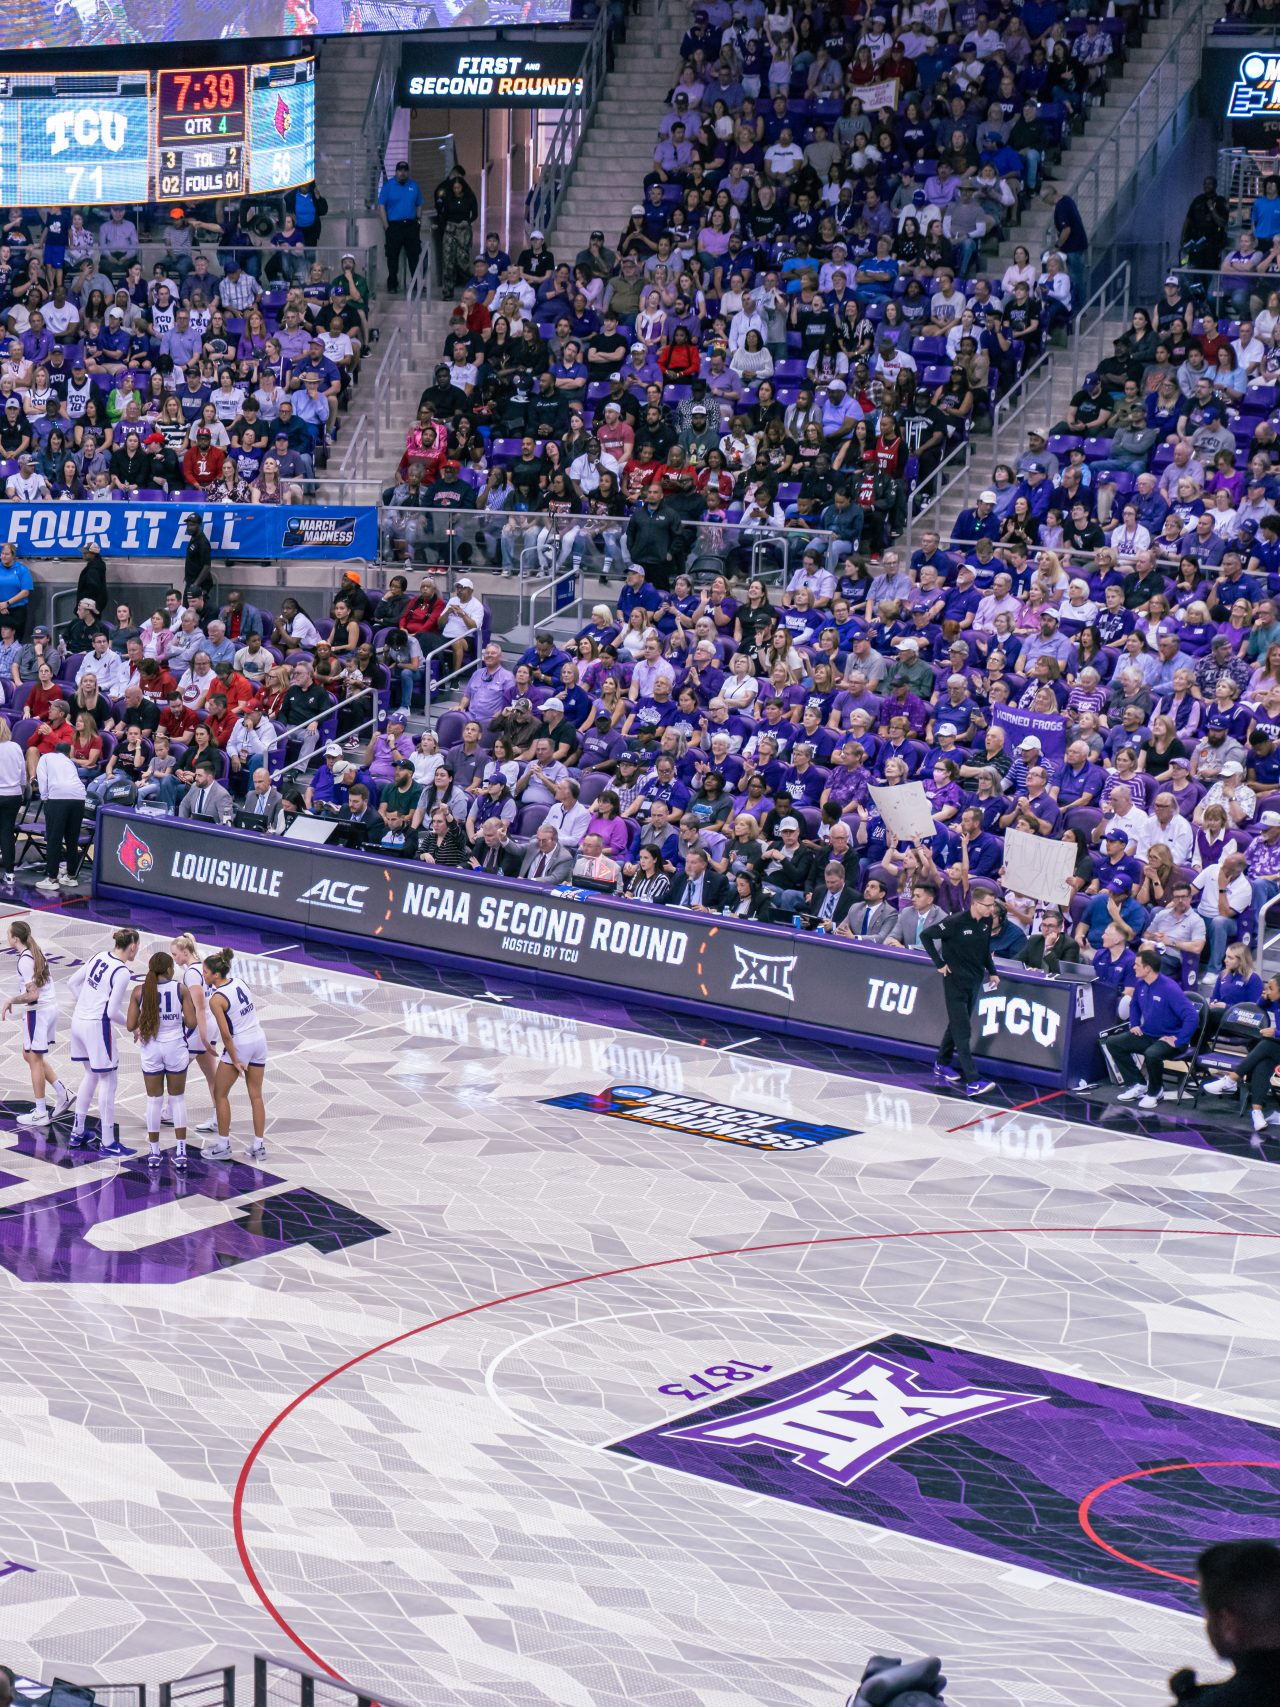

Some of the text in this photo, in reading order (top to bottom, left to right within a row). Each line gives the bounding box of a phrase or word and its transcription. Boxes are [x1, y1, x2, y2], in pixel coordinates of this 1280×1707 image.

[457, 57, 522, 74] FIRST
[173, 73, 235, 111] 7:39
[410, 78, 493, 95] SECOND
[46, 109, 128, 155] TCU
[185, 116, 227, 134] QTR 4
[167, 147, 237, 168] 3 TOL 2
[272, 151, 290, 185] 56
[66, 166, 103, 200] 71
[162, 172, 238, 193] 02 FOULS 01
[155, 316, 172, 325] TCU
[50, 374, 65, 383] TCU
[69, 395, 86, 404] TCU
[197, 460, 211, 476] L
[8, 510, 111, 548] FOUR
[121, 510, 167, 549] IT
[299, 519, 336, 531] MARCH
[303, 530, 353, 543] MADNESS
[996, 709, 1064, 732] HORNED FROGS
[1255, 723, 1279, 736] TCU
[171, 851, 283, 897] LOUISVILLE
[301, 878, 370, 907] ACC
[402, 882, 688, 966] NCAA SECOND ROUND
[501, 936, 578, 964] HOSTED BY TCU
[89, 959, 110, 983] 13
[236, 986, 249, 1005] 4
[867, 978, 918, 1015] TCU
[978, 995, 1061, 1048] TCU
[644, 1094, 785, 1129] MARCH
[623, 1106, 818, 1151] MADNESS
[657, 1358, 775, 1403] 1873
